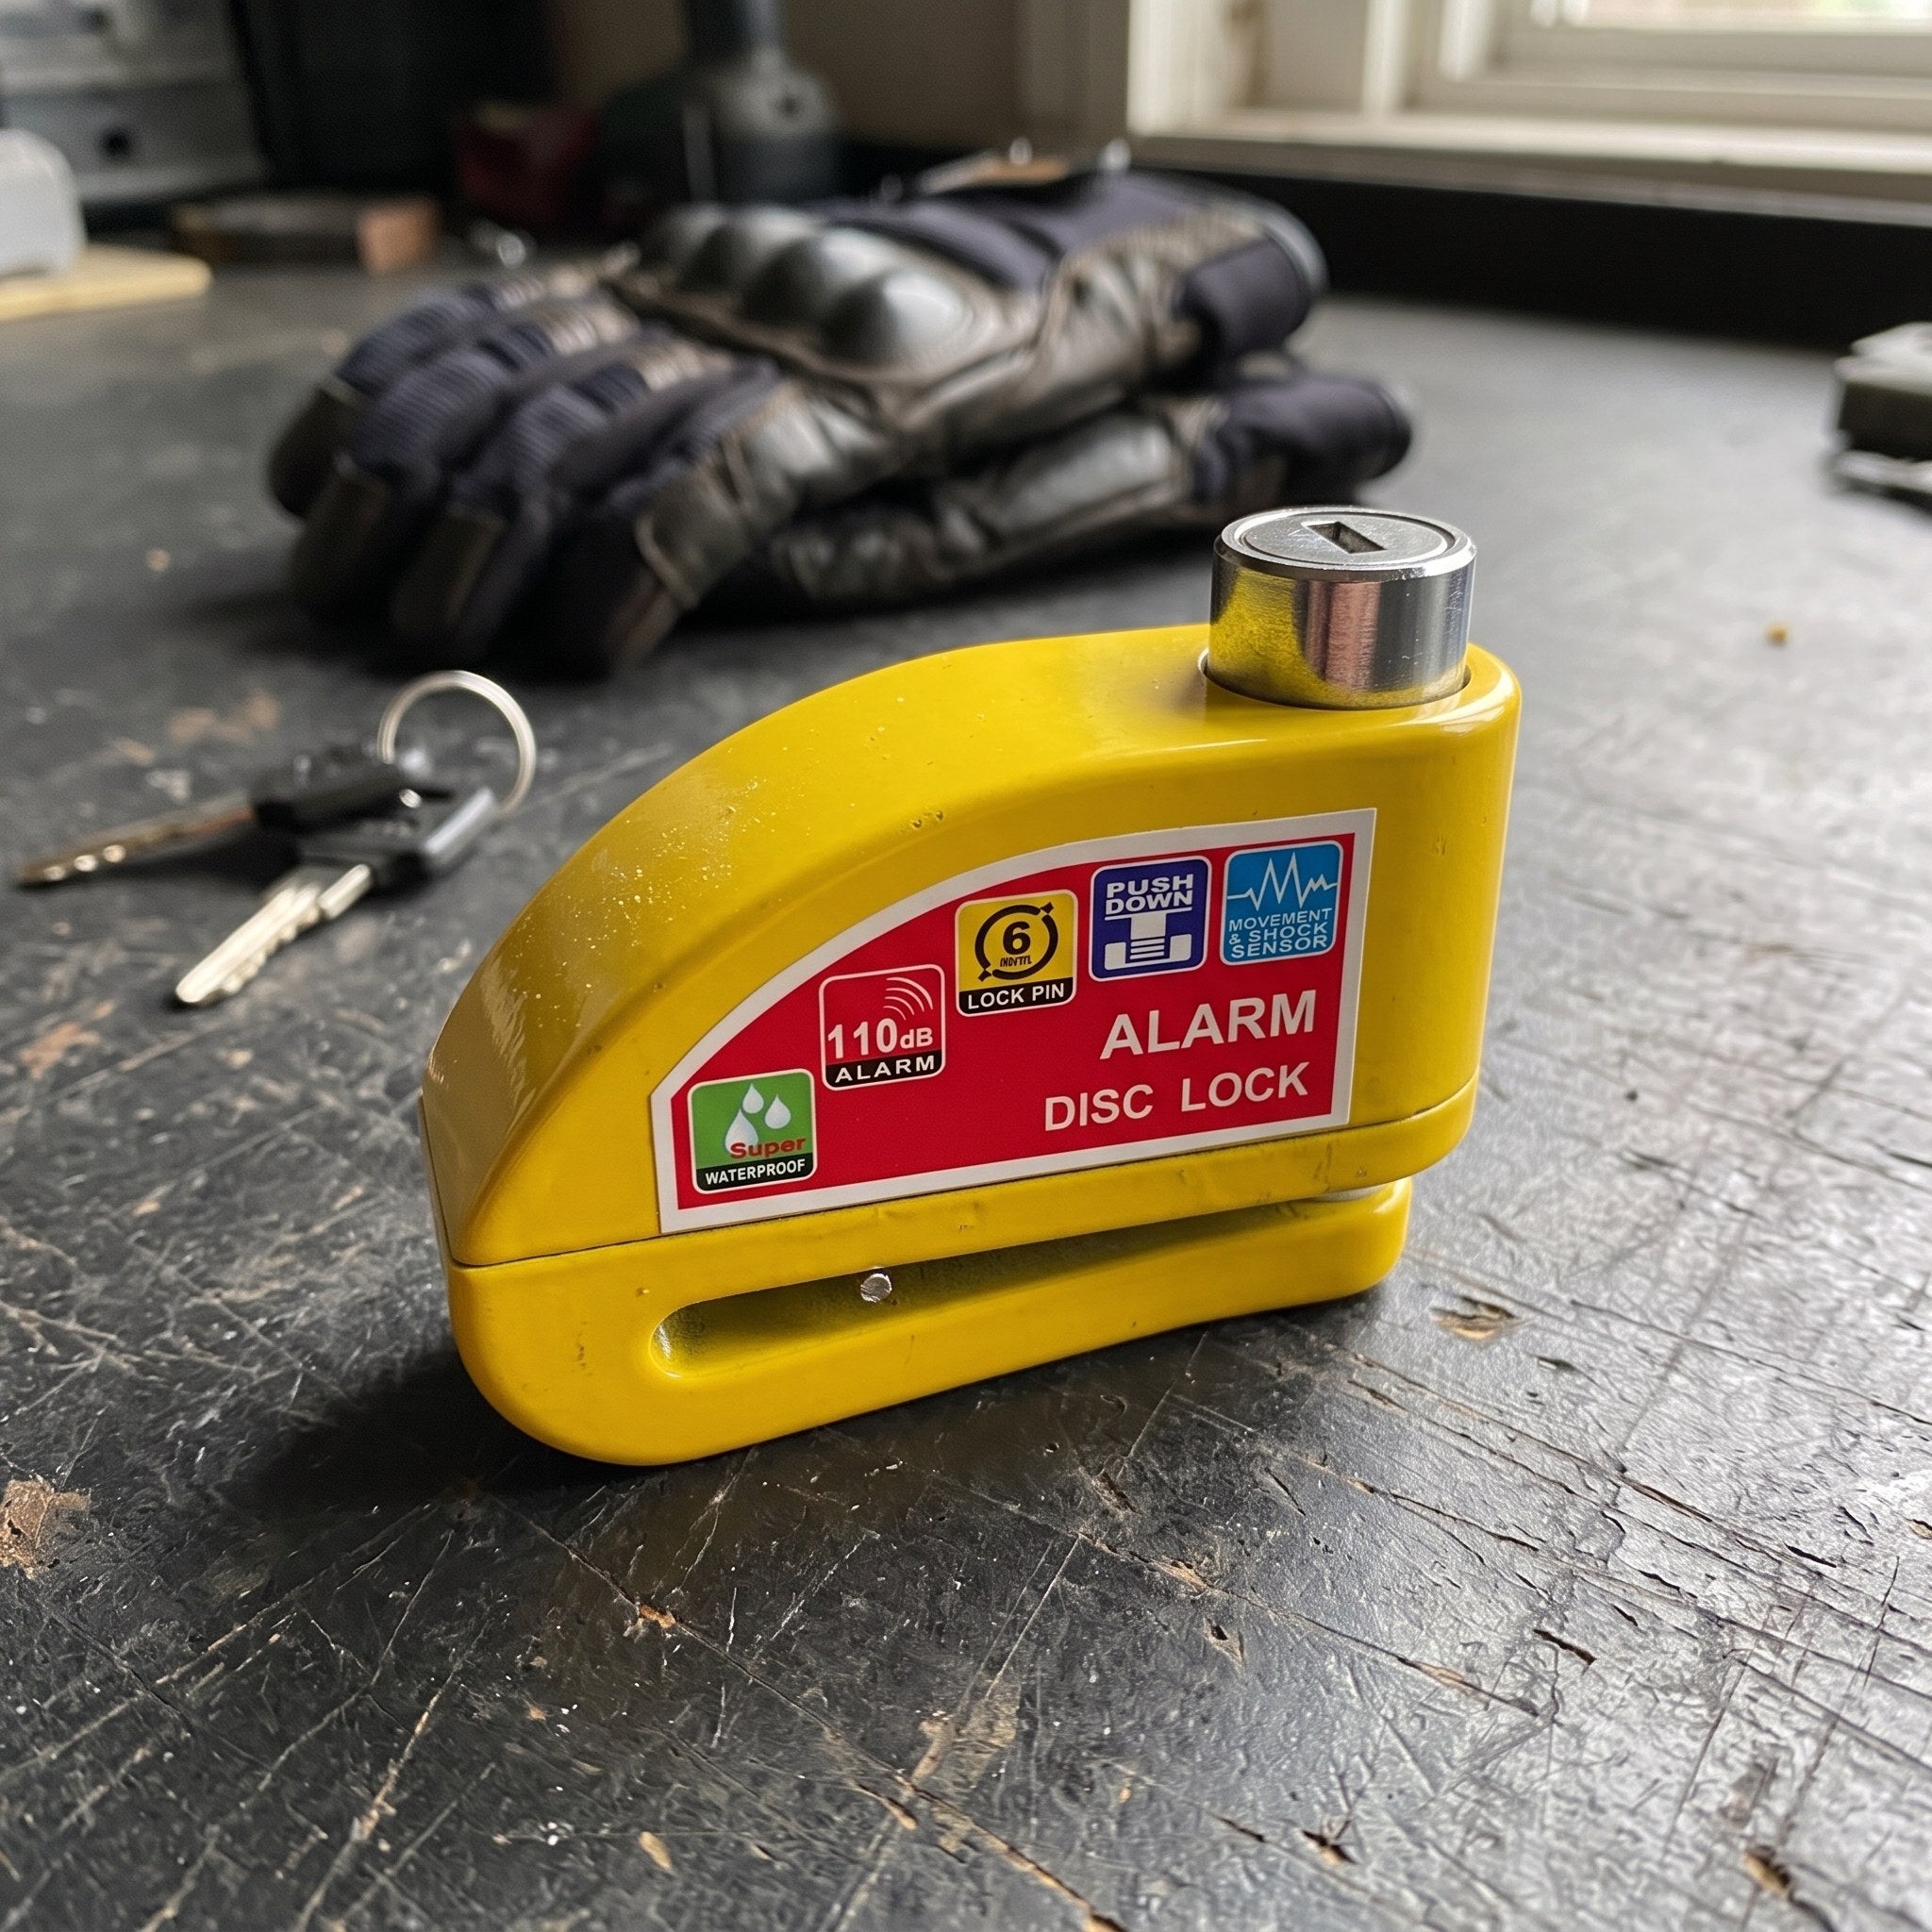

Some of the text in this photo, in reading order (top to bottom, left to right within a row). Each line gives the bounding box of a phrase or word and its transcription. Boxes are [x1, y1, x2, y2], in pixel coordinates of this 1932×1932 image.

[1106, 874, 1193, 897] PUSH
[1105, 890, 1192, 914] DOWN
[1228, 908, 1332, 930] MOVEMENT
[1003, 921, 1030, 955] 6
[1228, 921, 1328, 943] & SHOCK
[1230, 934, 1327, 958] SENSOR
[968, 982, 1064, 1008] LOCK PIN
[1099, 990, 1316, 1058] ALARM
[835, 1054, 934, 1082] ALARM
[1044, 1061, 1309, 1130] DISC LOCK
[729, 1138, 806, 1158] Super
[705, 1158, 805, 1185] WATERPROOF
